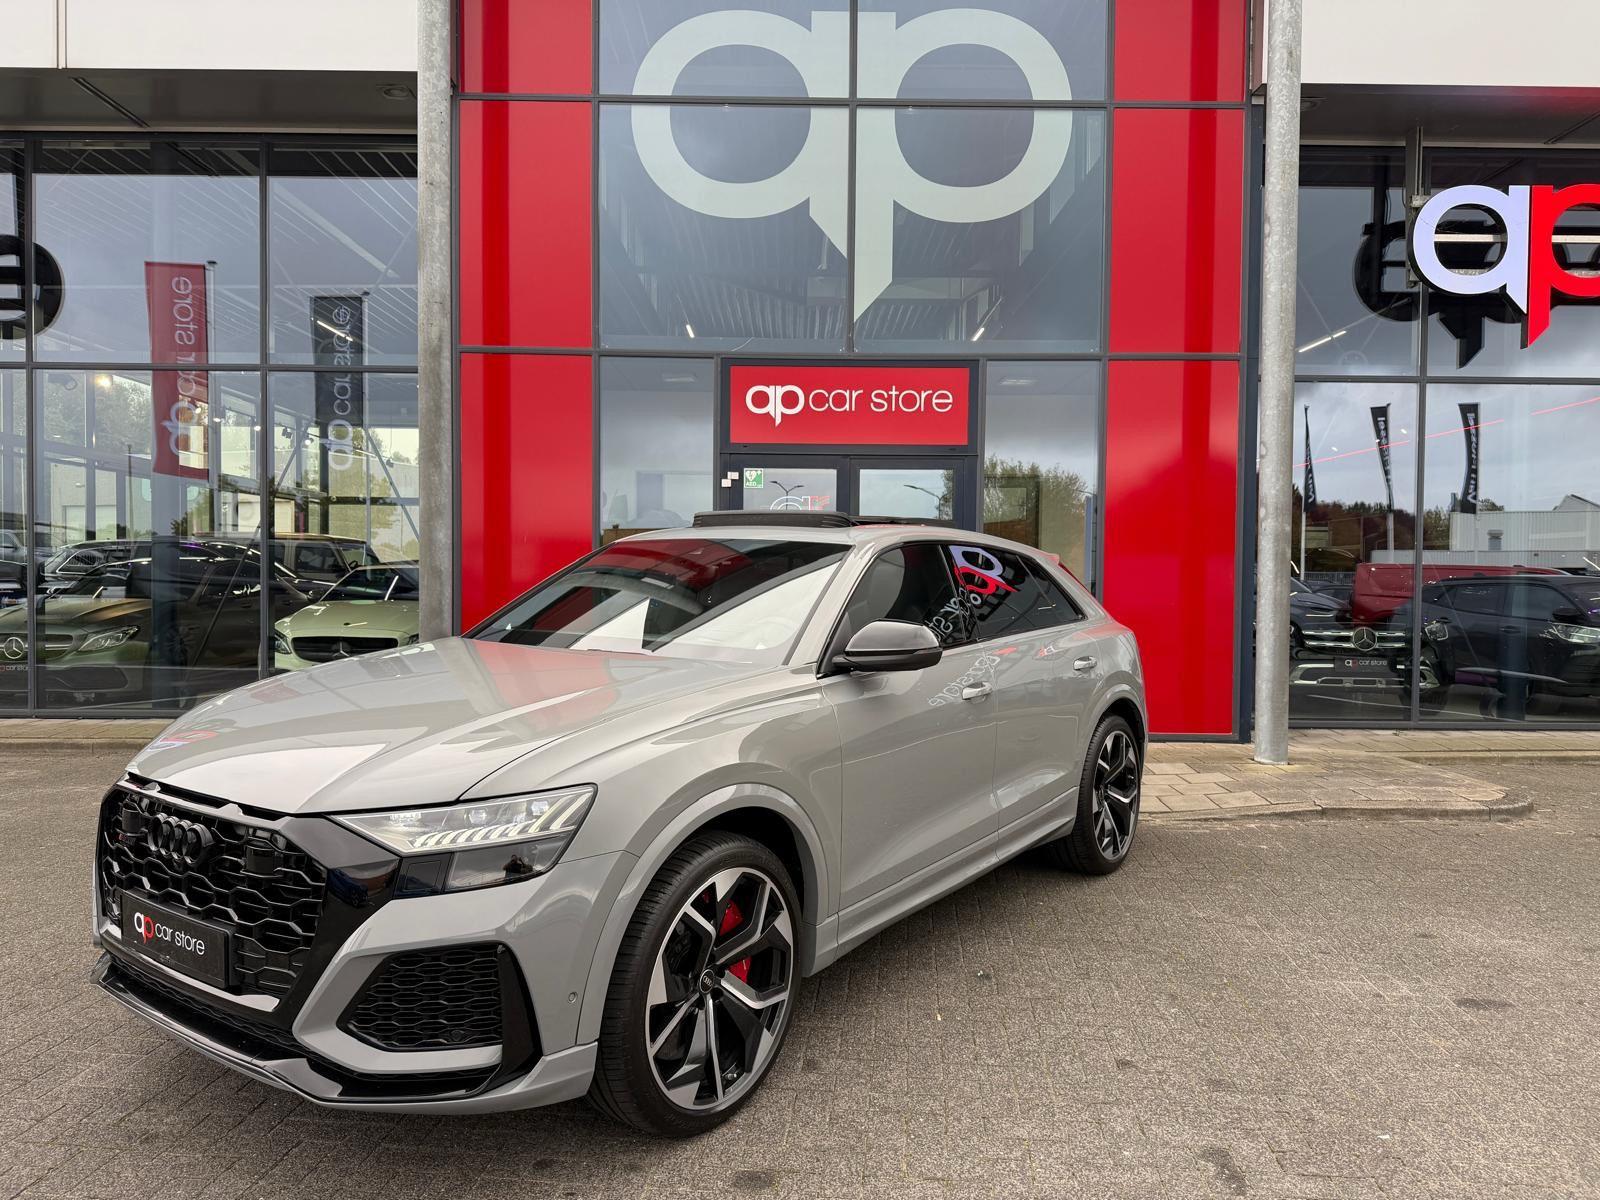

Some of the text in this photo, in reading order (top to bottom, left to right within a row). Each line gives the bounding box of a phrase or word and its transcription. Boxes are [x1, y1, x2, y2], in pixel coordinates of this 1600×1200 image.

[630, 7, 1073, 322] ap
[1412, 183, 1600, 348] ap
[745, 384, 954, 427] ap car store
[134, 912, 205, 955] ap car store
